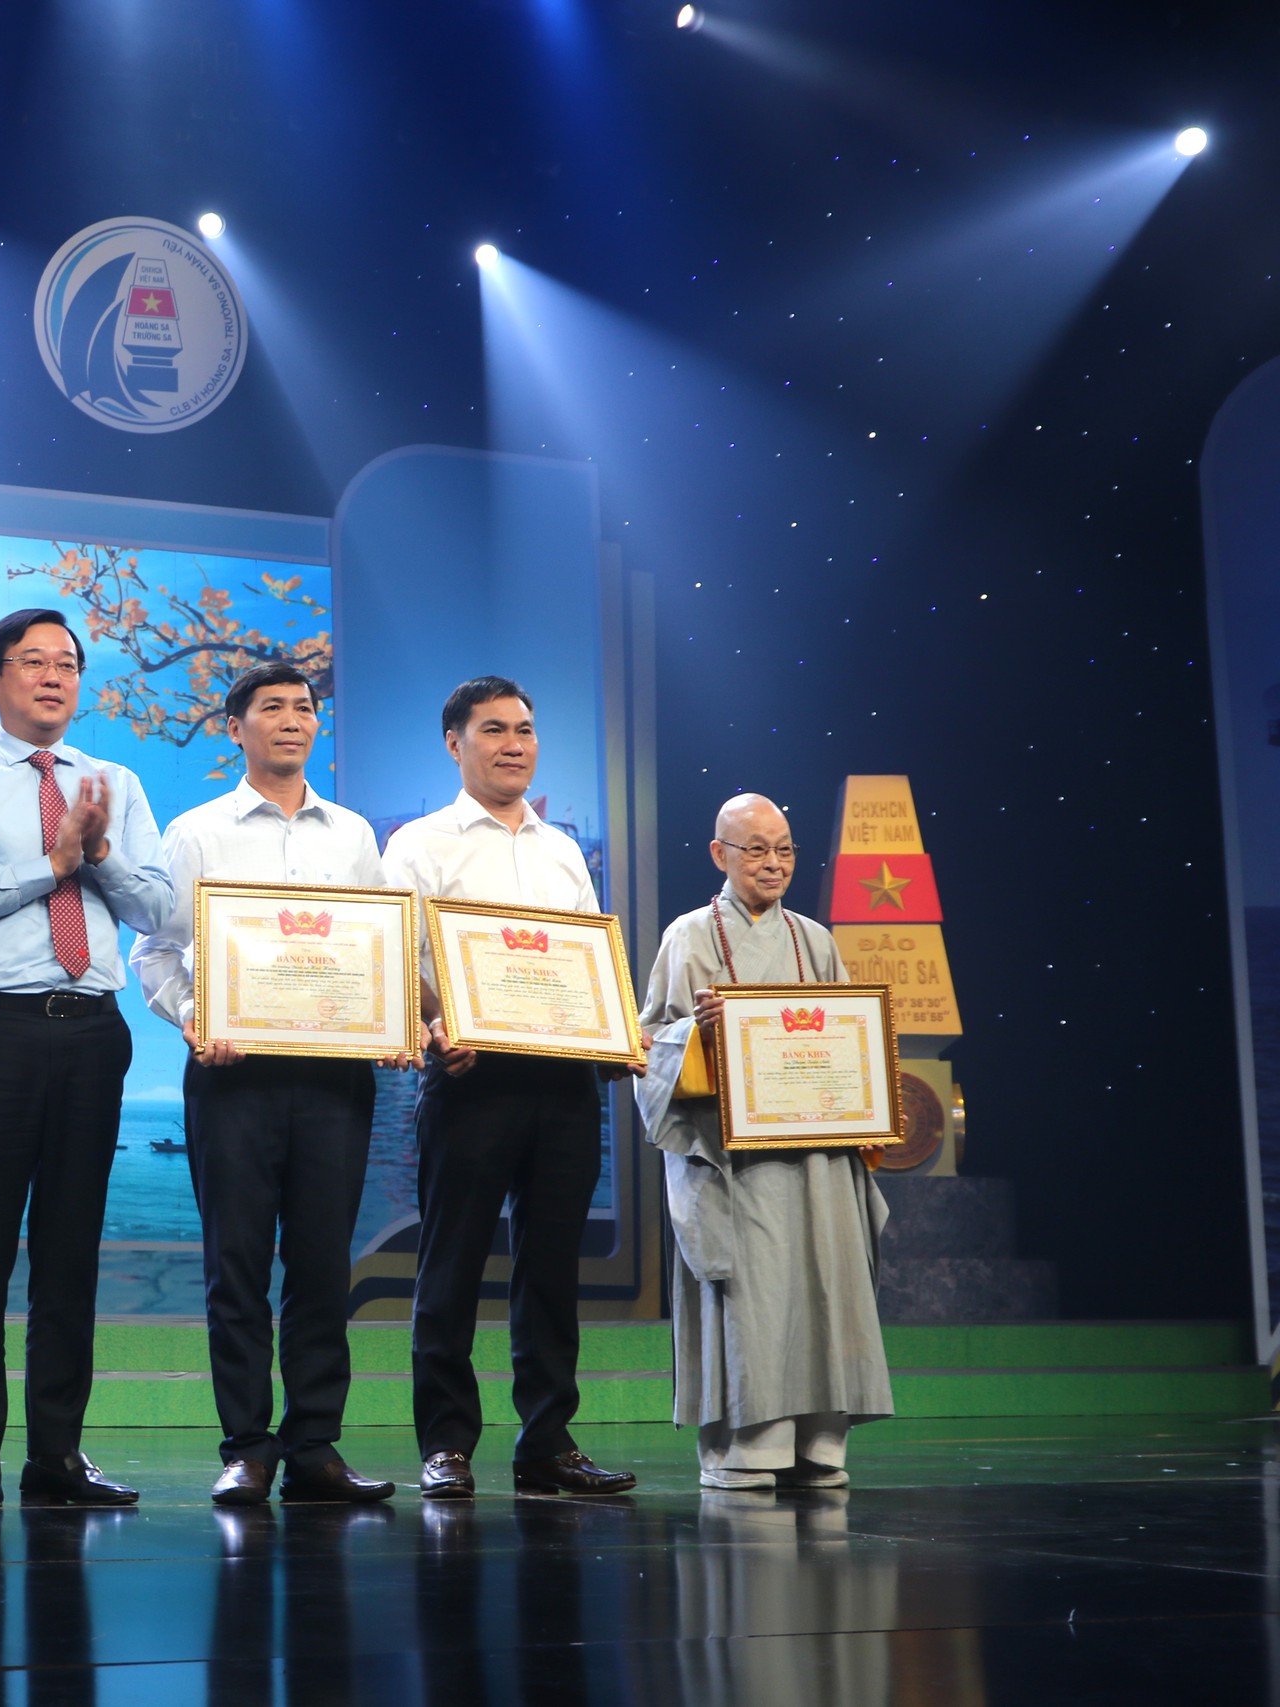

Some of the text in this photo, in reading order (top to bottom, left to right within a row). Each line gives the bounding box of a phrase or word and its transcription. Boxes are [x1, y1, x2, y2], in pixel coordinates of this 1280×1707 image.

[208, 274, 221, 290] SA
[160, 323, 170, 331] SA
[163, 334, 172, 342] SA
[221, 348, 233, 363] SA
[200, 363, 228, 399] HOÀNG
[170, 401, 191, 416] CLB
[851, 801, 907, 818] CHXHCN
[847, 821, 915, 845] VIỆT NAM
[857, 933, 917, 951] ĐẢO
[307, 956, 337, 965] KHEN
[533, 969, 559, 977] KHEN
[917, 959, 940, 985] SA
